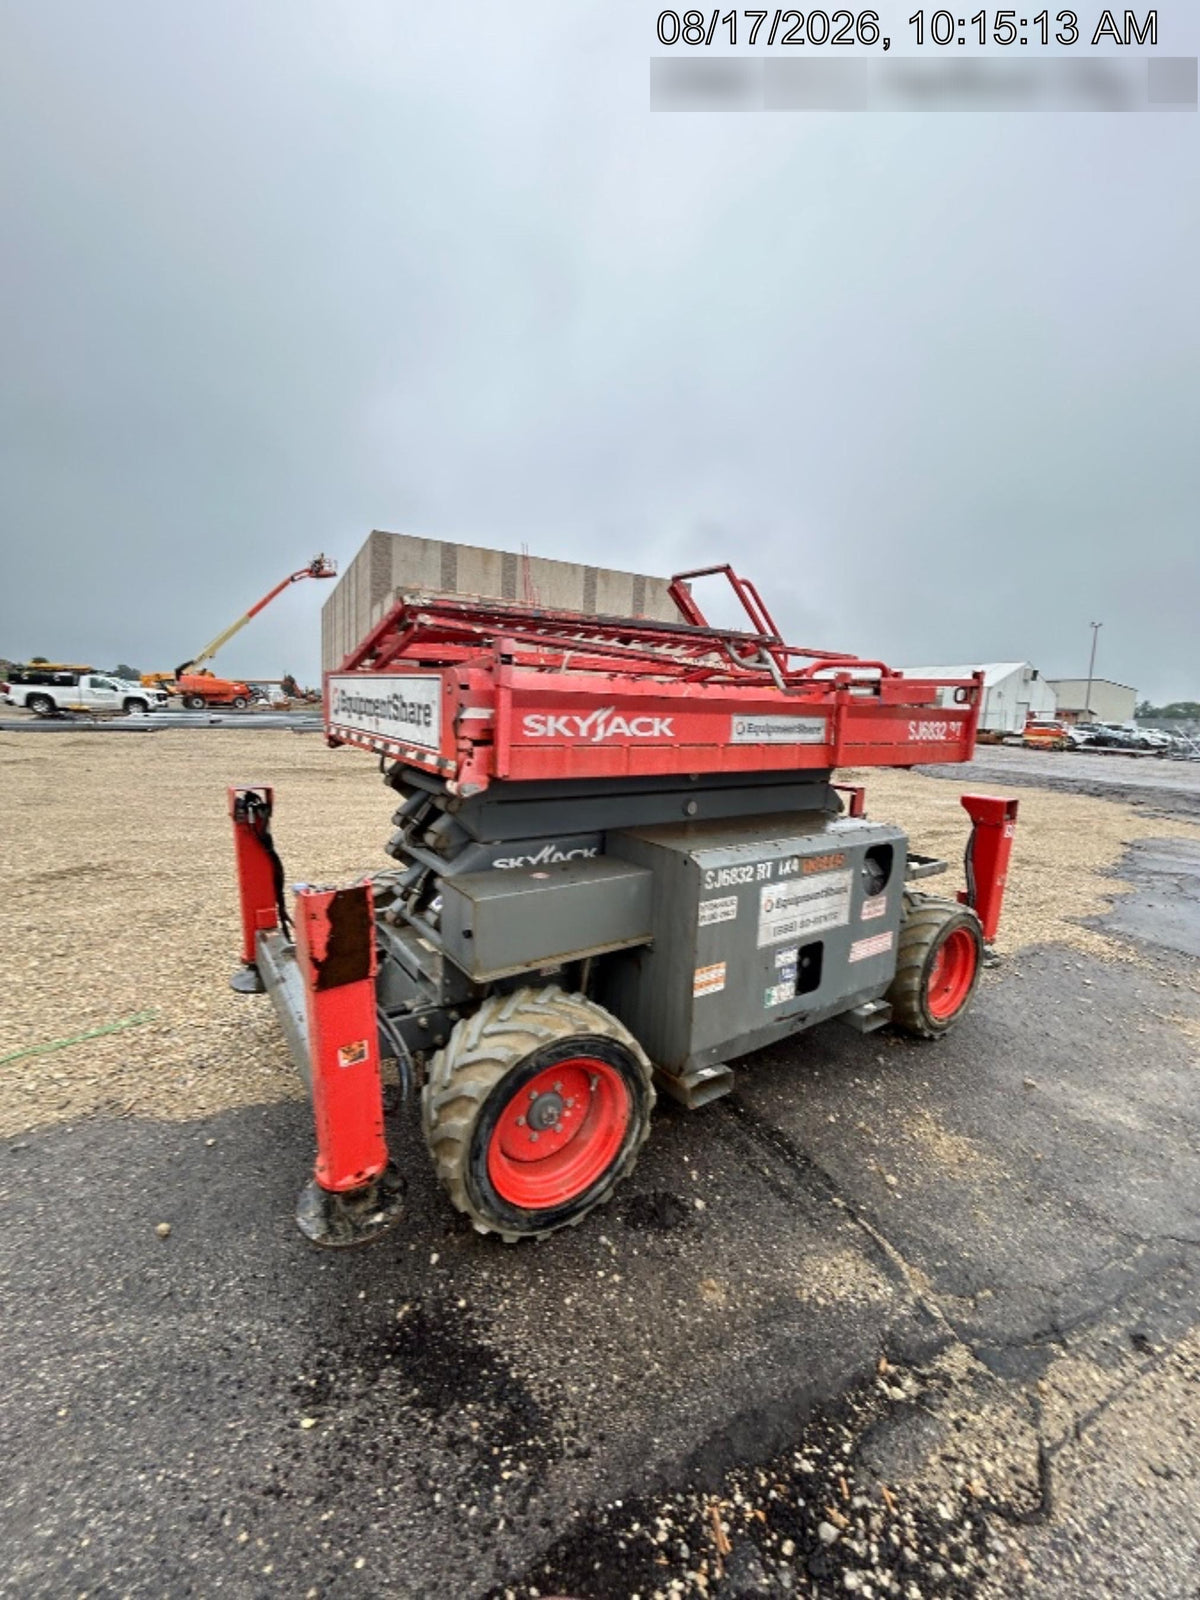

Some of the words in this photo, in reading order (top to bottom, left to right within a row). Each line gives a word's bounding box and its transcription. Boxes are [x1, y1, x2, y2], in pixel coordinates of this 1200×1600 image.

[338, 688, 432, 727] EquipmentShare
[522, 706, 675, 743] SKYJACK
[704, 865, 754, 890] SJ6832
[756, 861, 774, 881] RT
